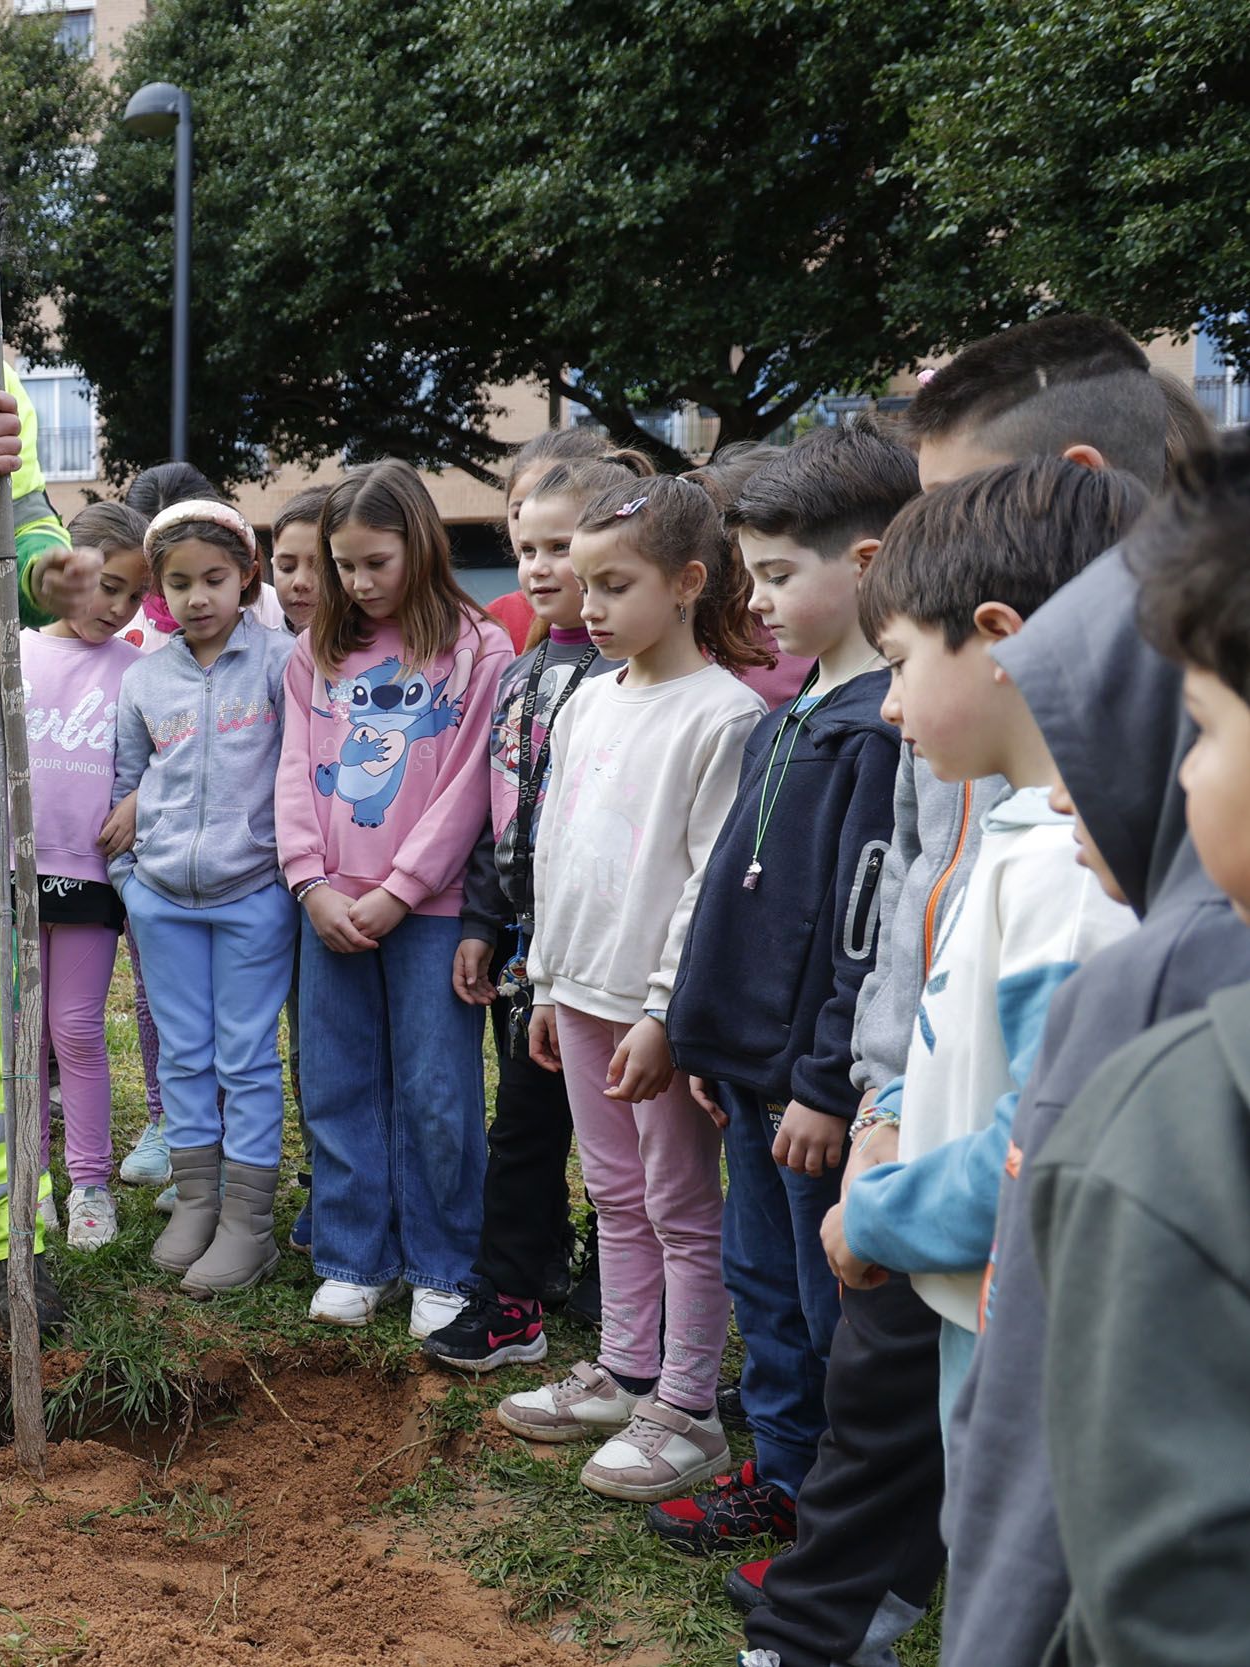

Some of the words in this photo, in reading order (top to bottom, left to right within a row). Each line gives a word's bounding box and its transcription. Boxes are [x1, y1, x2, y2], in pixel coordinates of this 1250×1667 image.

[22, 678, 116, 752] arbi
[523, 690, 536, 717] ADLV
[520, 734, 530, 762] ADLV
[66, 760, 110, 776] UNIQUE
